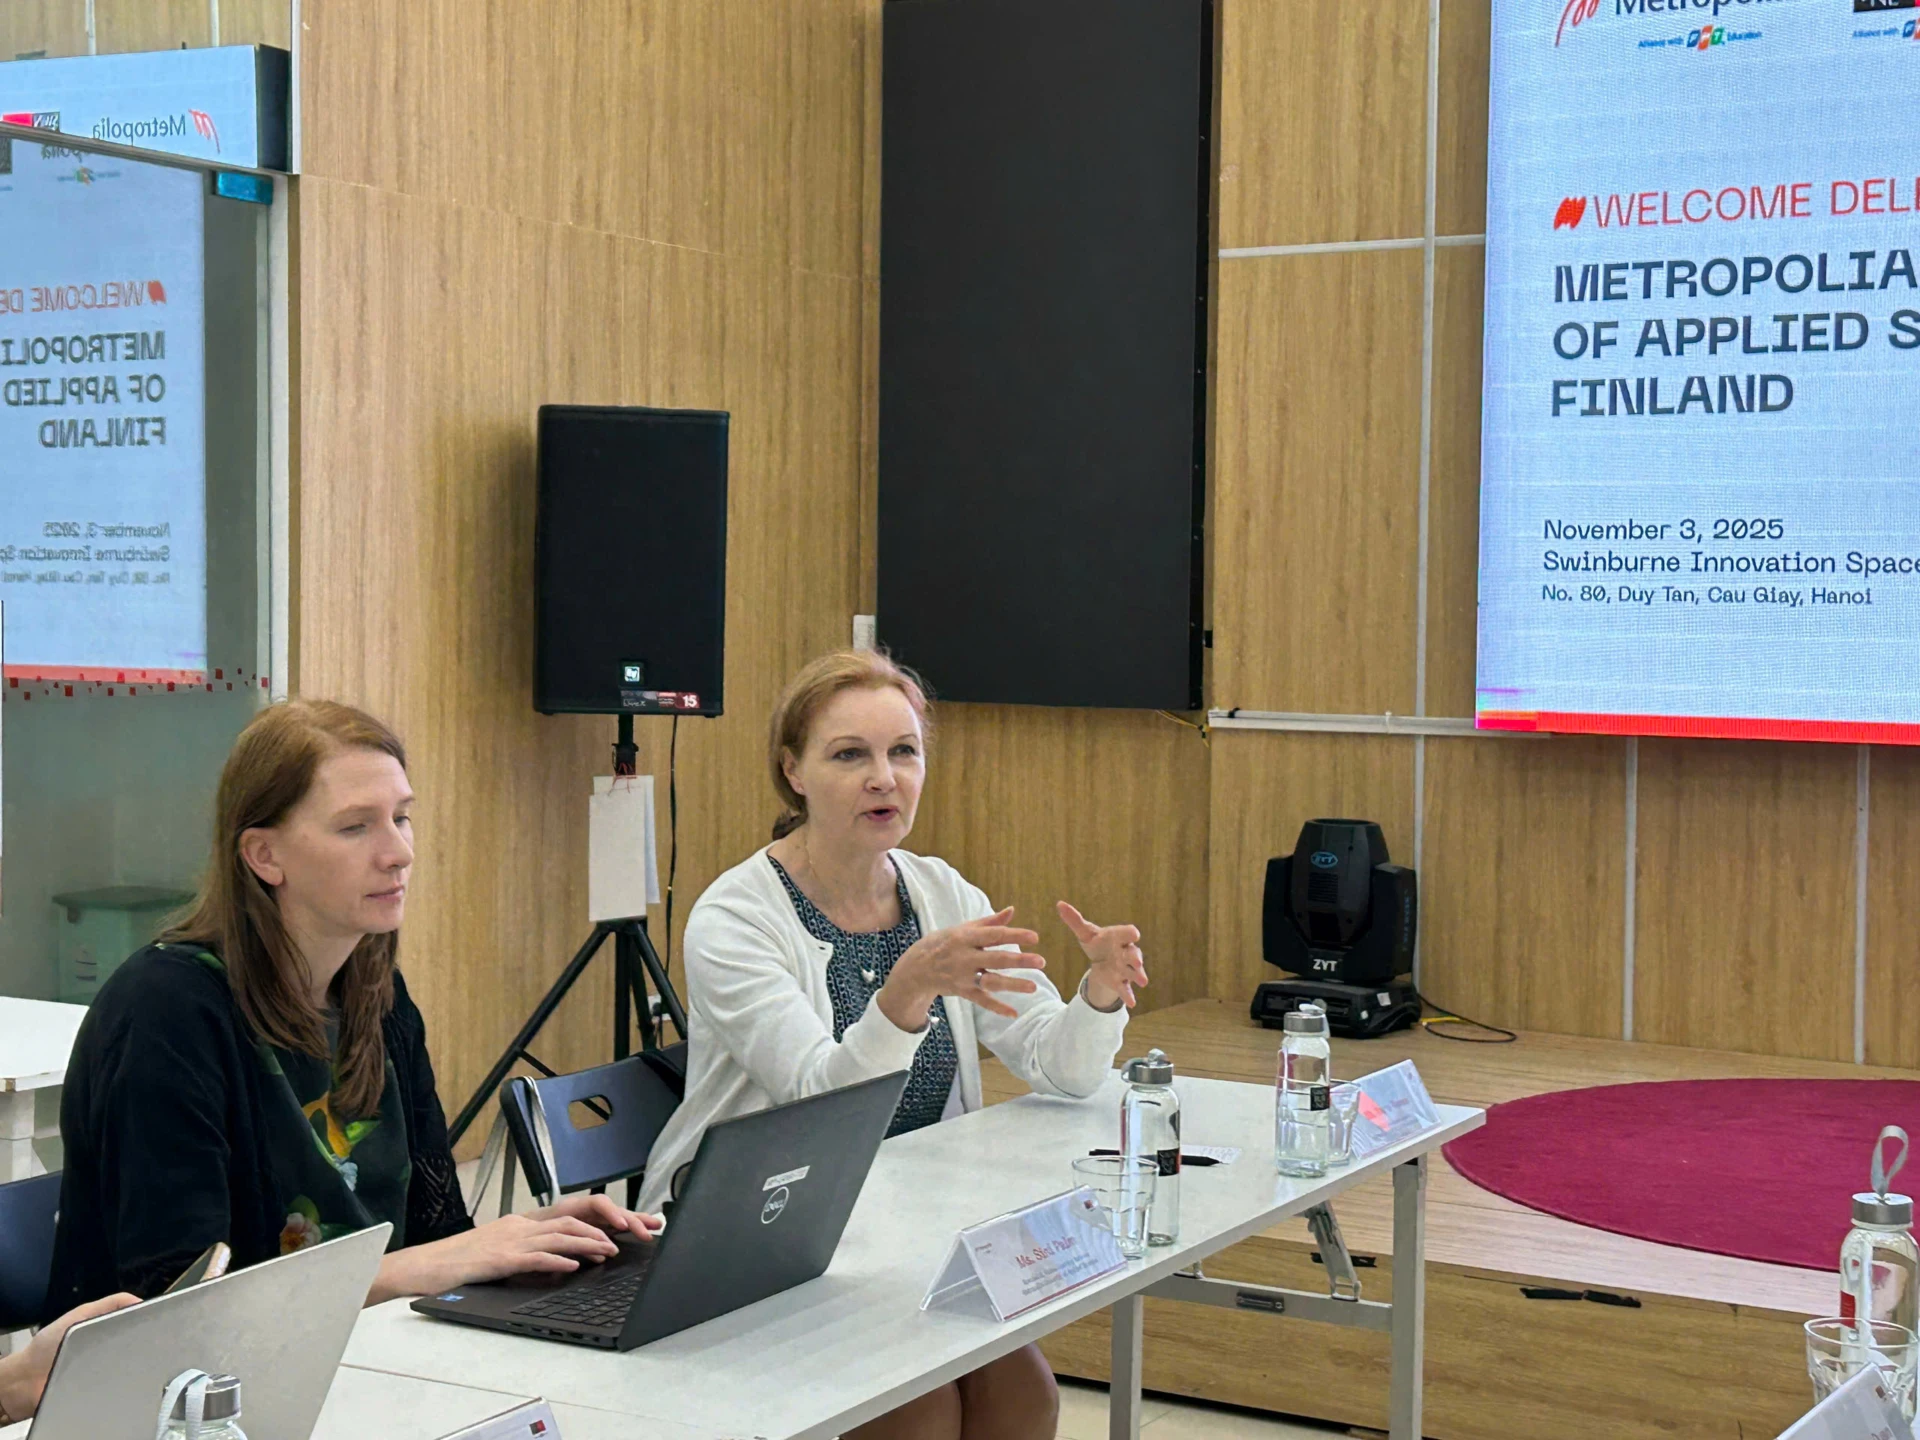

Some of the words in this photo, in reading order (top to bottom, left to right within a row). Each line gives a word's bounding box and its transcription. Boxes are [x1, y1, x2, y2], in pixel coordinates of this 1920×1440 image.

[1593, 182, 1812, 228] WELCOME
[1554, 249, 1918, 303] METROPOLIA
[1553, 320, 1619, 360] OF
[1634, 312, 1869, 357] APPLIED
[1552, 373, 1794, 417] FINLAND
[1543, 518, 1672, 540] November
[1679, 518, 1702, 544] 3,
[1713, 518, 1784, 539] 2025
[1543, 550, 1680, 572] Swinburne
[1691, 551, 1836, 573] Innovation
[1542, 583, 1573, 602] No.
[1580, 585, 1612, 604] 80,
[1618, 586, 1655, 606] Duy
[1662, 586, 1700, 606] Tan,
[1708, 586, 1746, 604] Cau
[1811, 587, 1873, 605] Hanoi
[682, 694, 698, 708] 15
[1313, 958, 1338, 972] ZYT
